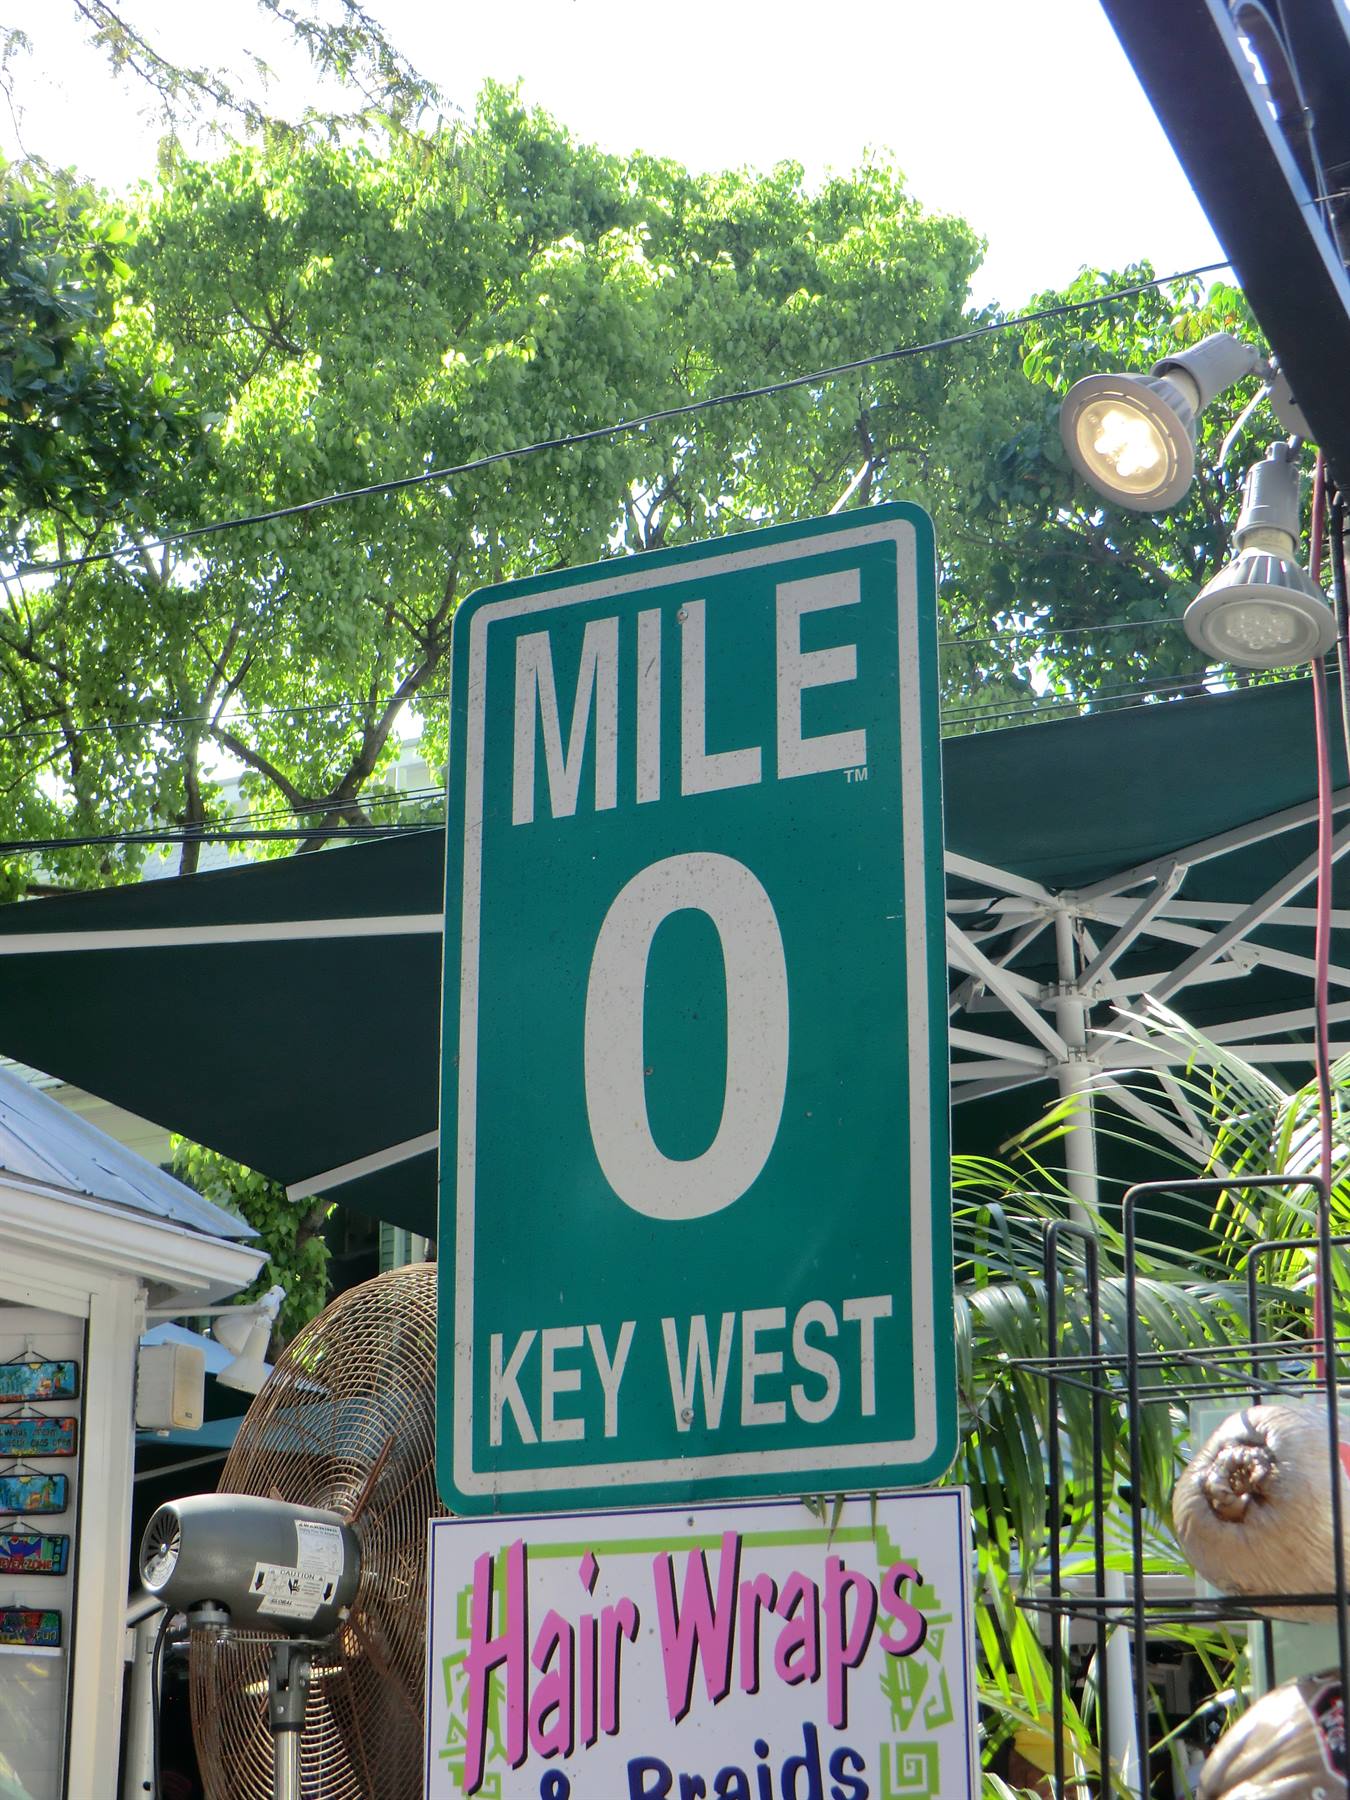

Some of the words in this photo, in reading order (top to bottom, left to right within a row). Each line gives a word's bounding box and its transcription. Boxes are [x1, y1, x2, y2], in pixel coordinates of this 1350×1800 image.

[512, 568, 867, 826] MILE
[843, 767, 868, 783] TM
[584, 852, 790, 1221] 0
[490, 1320, 637, 1447] KEY
[661, 1295, 893, 1433] WEST
[280, 1569, 315, 1581] CAUTION
[462, 1537, 641, 1796] Hair
[653, 1530, 927, 1731] Wraps
